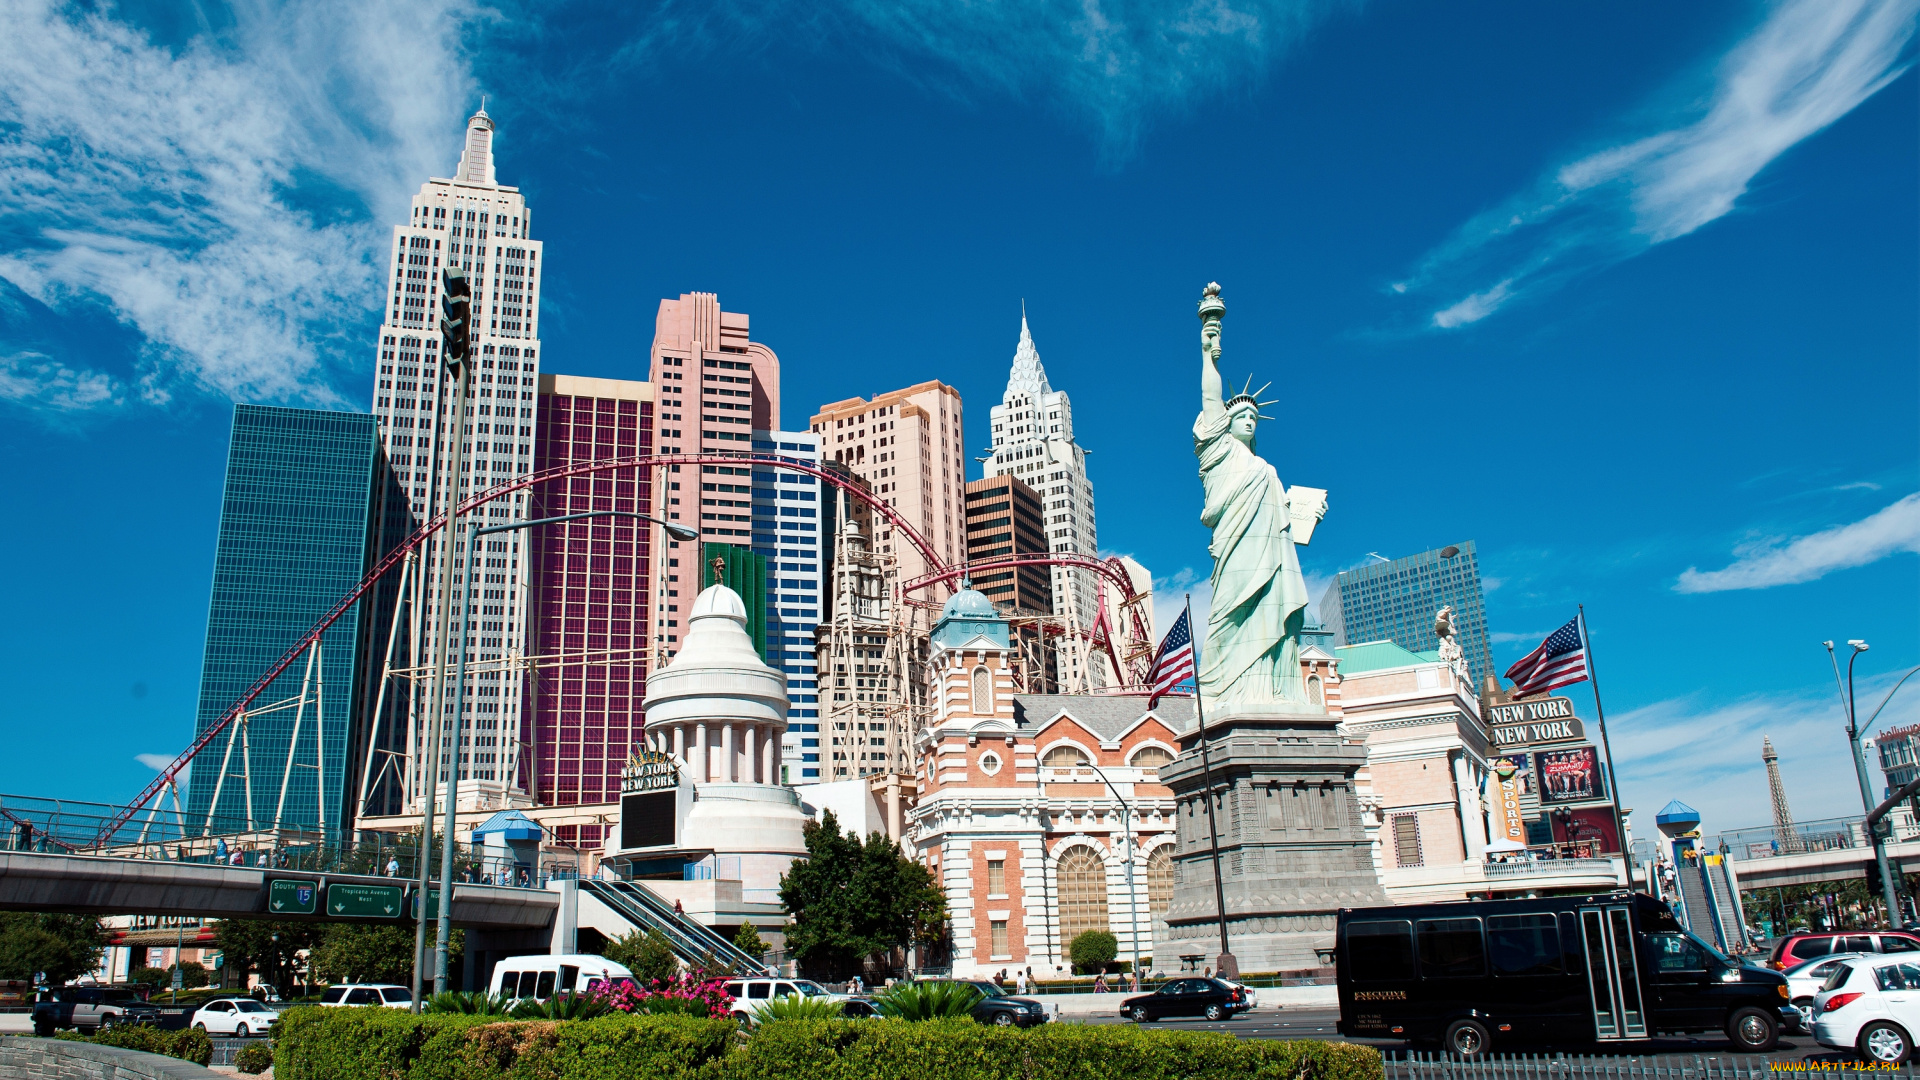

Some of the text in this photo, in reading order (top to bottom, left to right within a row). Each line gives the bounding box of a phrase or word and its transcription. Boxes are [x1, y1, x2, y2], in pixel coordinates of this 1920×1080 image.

[1491, 699, 1571, 724] NEW YORK
[1494, 720, 1574, 745] NEW YORK
[1879, 723, 1920, 742] hollywo
[621, 762, 676, 779] NEW YORK
[1549, 762, 1585, 772] ZUMANITY
[621, 774, 676, 791] NEW YORK
[1501, 780, 1521, 837] SPORTS
[274, 882, 296, 890] SOUTH
[299, 890, 311, 901] 15
[129, 914, 157, 926] NEW
[1659, 911, 1672, 919] 245
